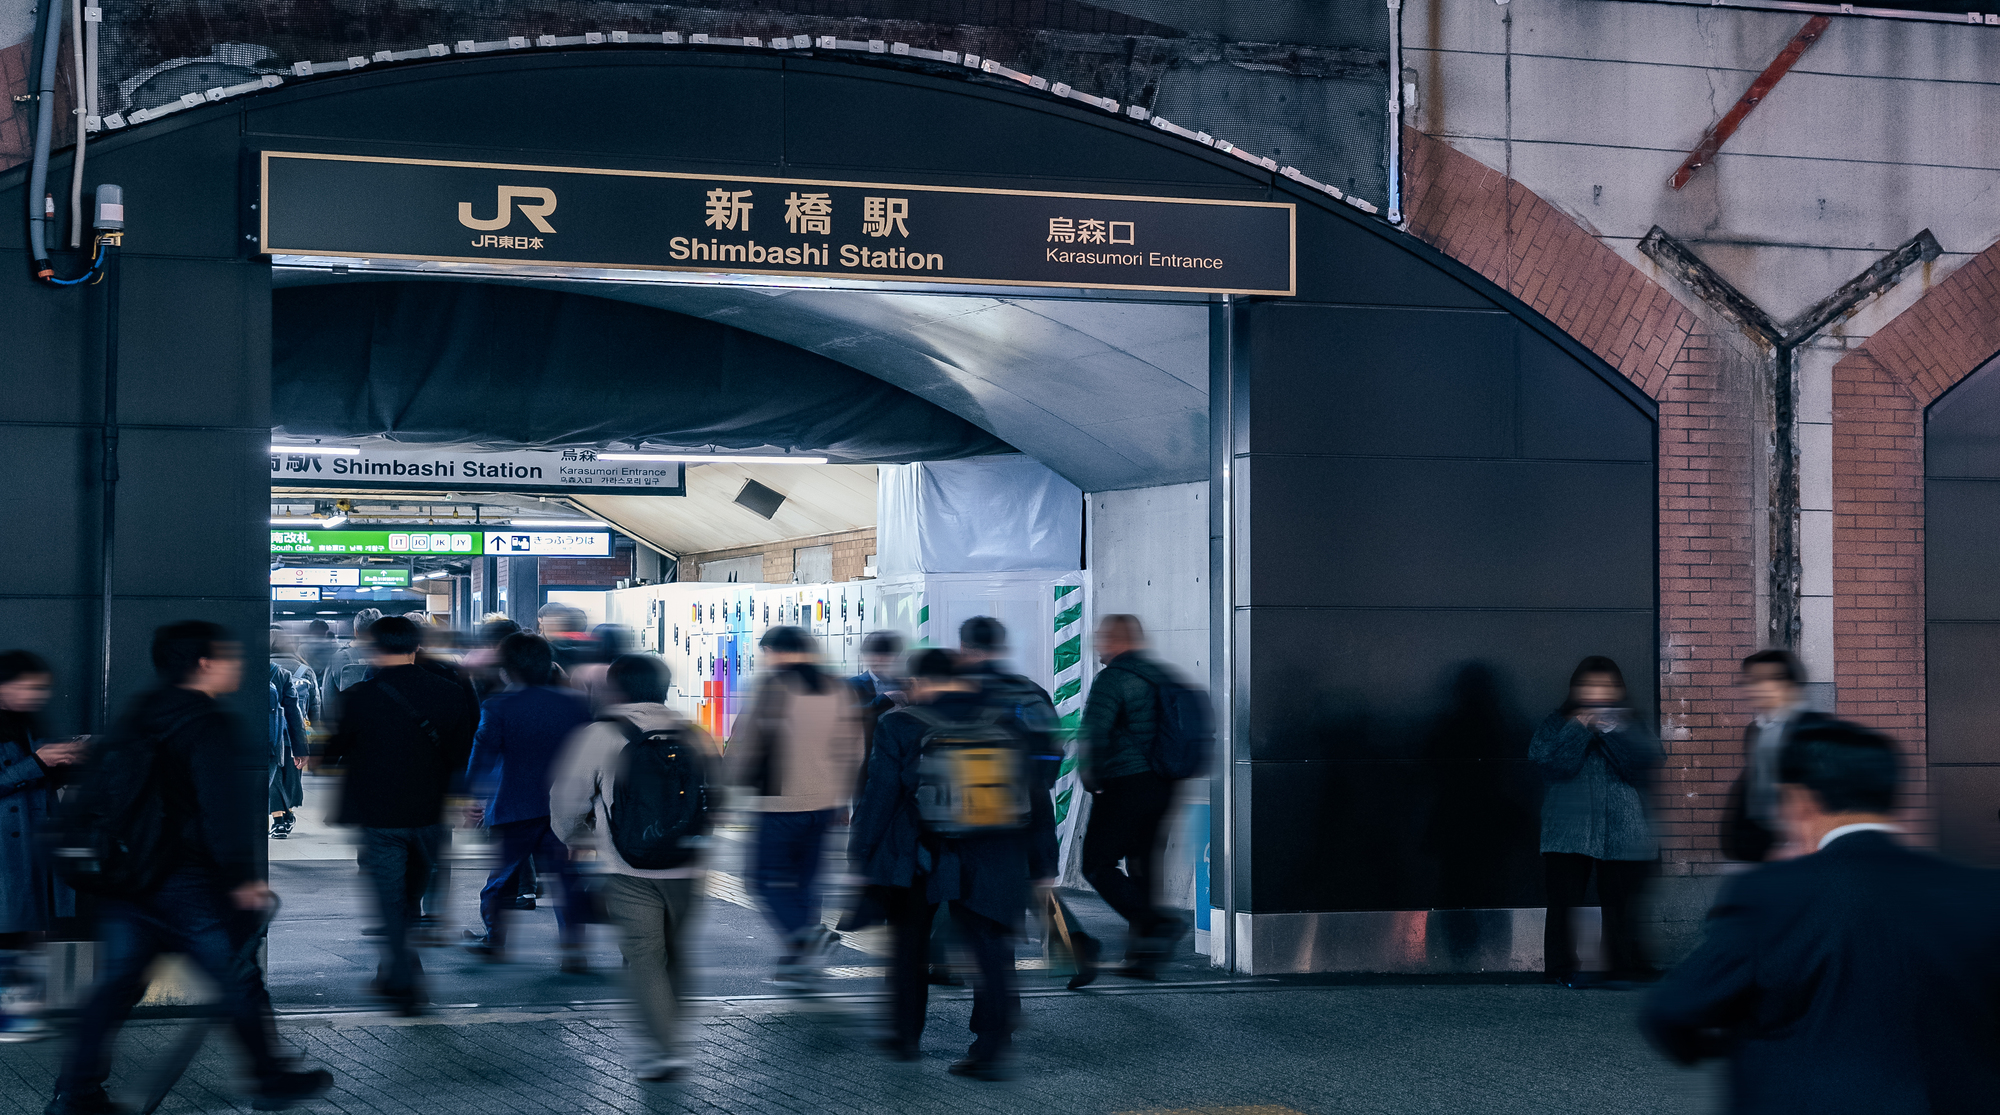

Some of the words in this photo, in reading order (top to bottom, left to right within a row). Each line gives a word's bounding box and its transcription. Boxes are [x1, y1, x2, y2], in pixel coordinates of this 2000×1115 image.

[458, 185, 558, 234] JR
[705, 188, 909, 238] 新橋駅
[471, 234, 544, 250] JR東日本
[1046, 216, 1135, 246] 烏森口
[669, 236, 829, 266] Shimbashi
[839, 244, 944, 271] Station
[1046, 248, 1143, 266] Karasumori
[1149, 252, 1223, 270] Entrance
[333, 457, 455, 477] Shimbashi
[462, 460, 543, 479] Station
[559, 465, 618, 477] Karasumori
[621, 467, 667, 477] Entrance
[271, 544, 294, 552] South
[295, 544, 315, 552] Gate
